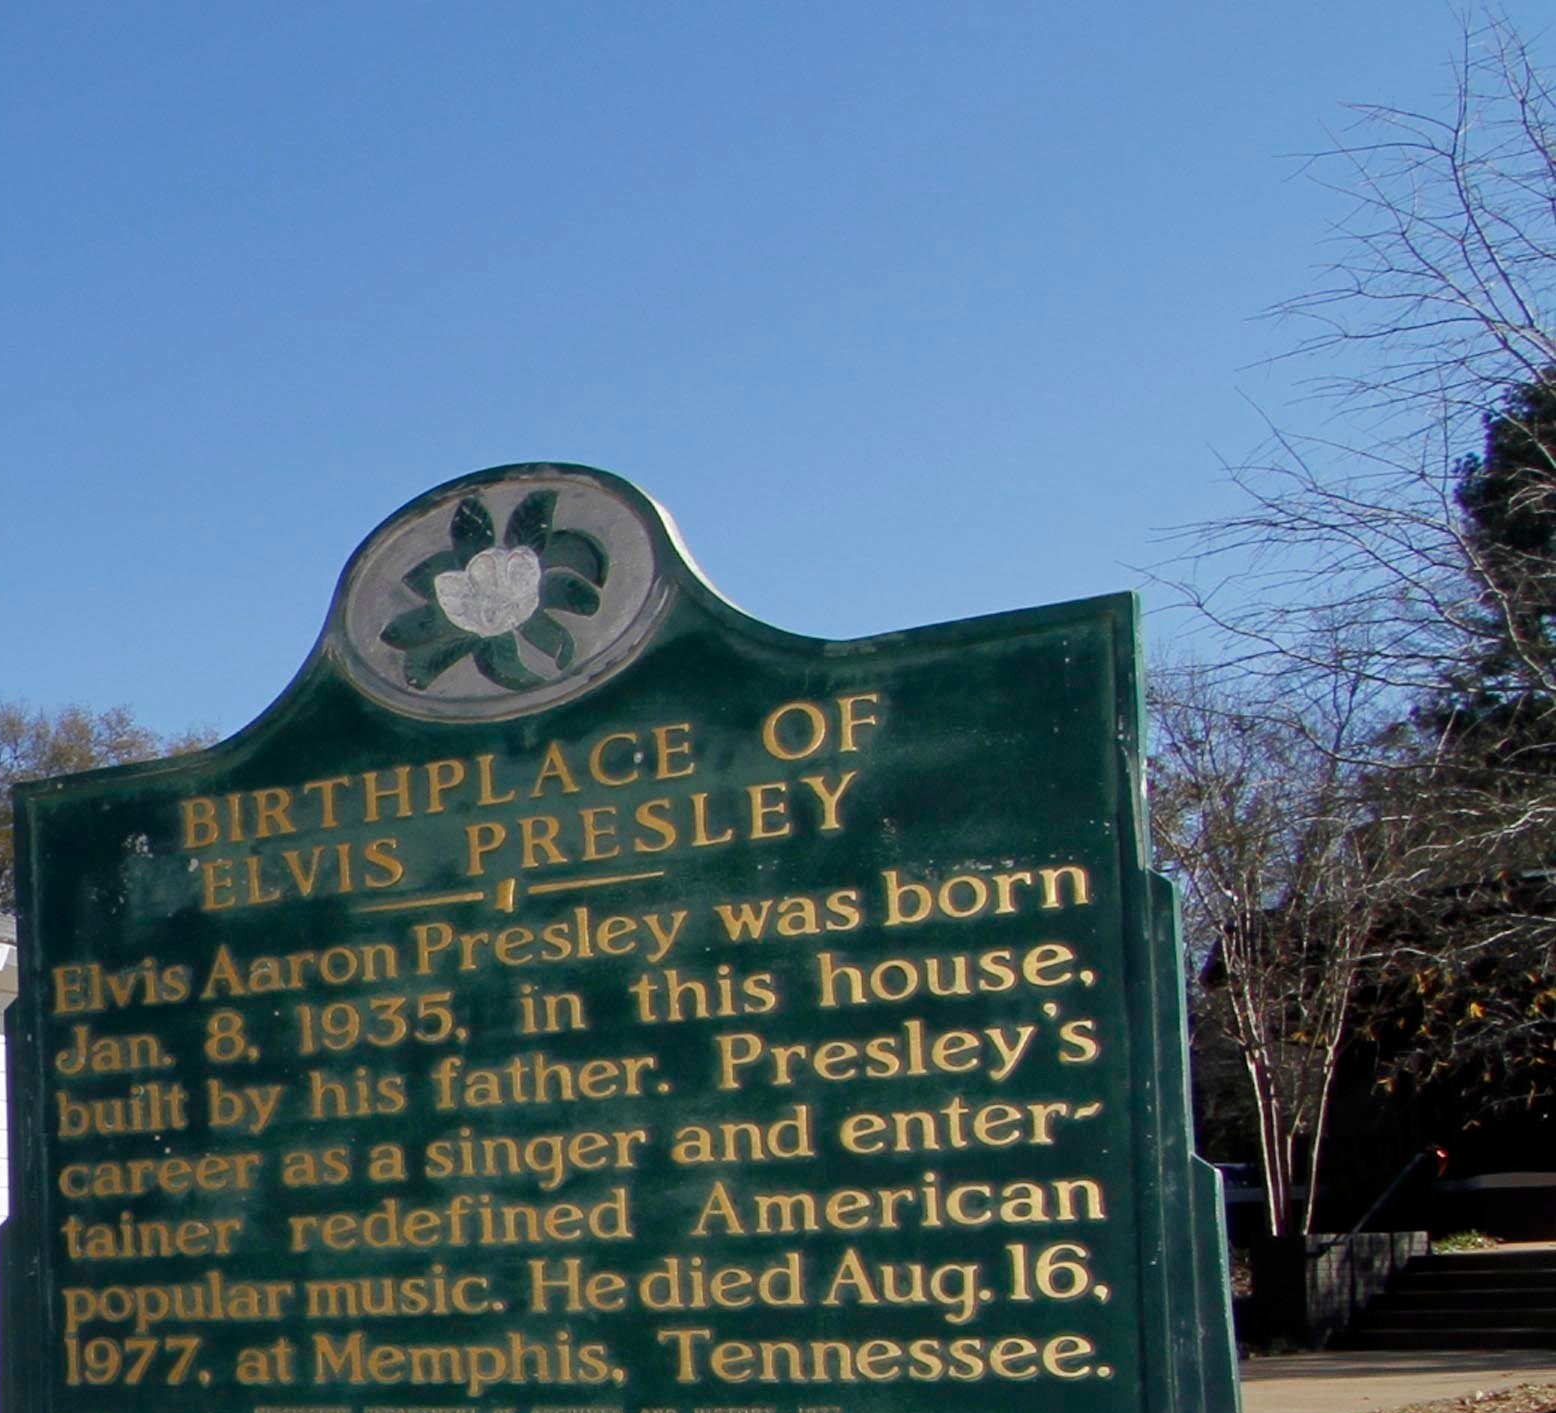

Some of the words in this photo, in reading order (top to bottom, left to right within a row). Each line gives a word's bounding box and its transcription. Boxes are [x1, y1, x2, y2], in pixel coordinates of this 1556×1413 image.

[182, 722, 695, 849] BIRTHPLACE
[762, 693, 879, 760] OF
[201, 836, 405, 911] ELVIS
[465, 771, 857, 876] PRESLEY
[51, 957, 189, 1015] Elvis
[200, 943, 399, 999] Aaron
[412, 907, 687, 974] Presley
[713, 888, 860, 941] was
[882, 864, 1090, 926] born
[54, 1025, 176, 1075] Jan.
[204, 1010, 260, 1063] 8,
[296, 990, 467, 1054] 1935,
[519, 983, 585, 1034] in
[629, 964, 777, 1023] this
[816, 943, 1096, 1008] house,
[55, 1082, 188, 1138] built
[206, 1078, 282, 1134] by
[307, 1067, 407, 1119] his
[432, 1052, 671, 1109] father.
[714, 1002, 1100, 1090] Presley's
[58, 1152, 261, 1198] career
[282, 1145, 350, 1186] as
[368, 1142, 408, 1182] a
[425, 1126, 647, 1191] singer
[671, 1104, 815, 1164] and
[839, 1096, 1102, 1154] enter-
[61, 1210, 240, 1259] tainer
[290, 1188, 632, 1251] redefined
[690, 1171, 1105, 1235] American
[62, 1271, 292, 1332] popular
[306, 1265, 506, 1318] music.
[529, 1258, 626, 1313] He
[639, 1252, 805, 1310] died
[826, 1248, 994, 1323] Aug.
[1007, 1243, 1111, 1303] 16,
[65, 1334, 211, 1386] 1977,
[235, 1338, 292, 1384] at
[313, 1330, 627, 1397] Memphis,
[658, 1328, 1113, 1383] Tennessee.
